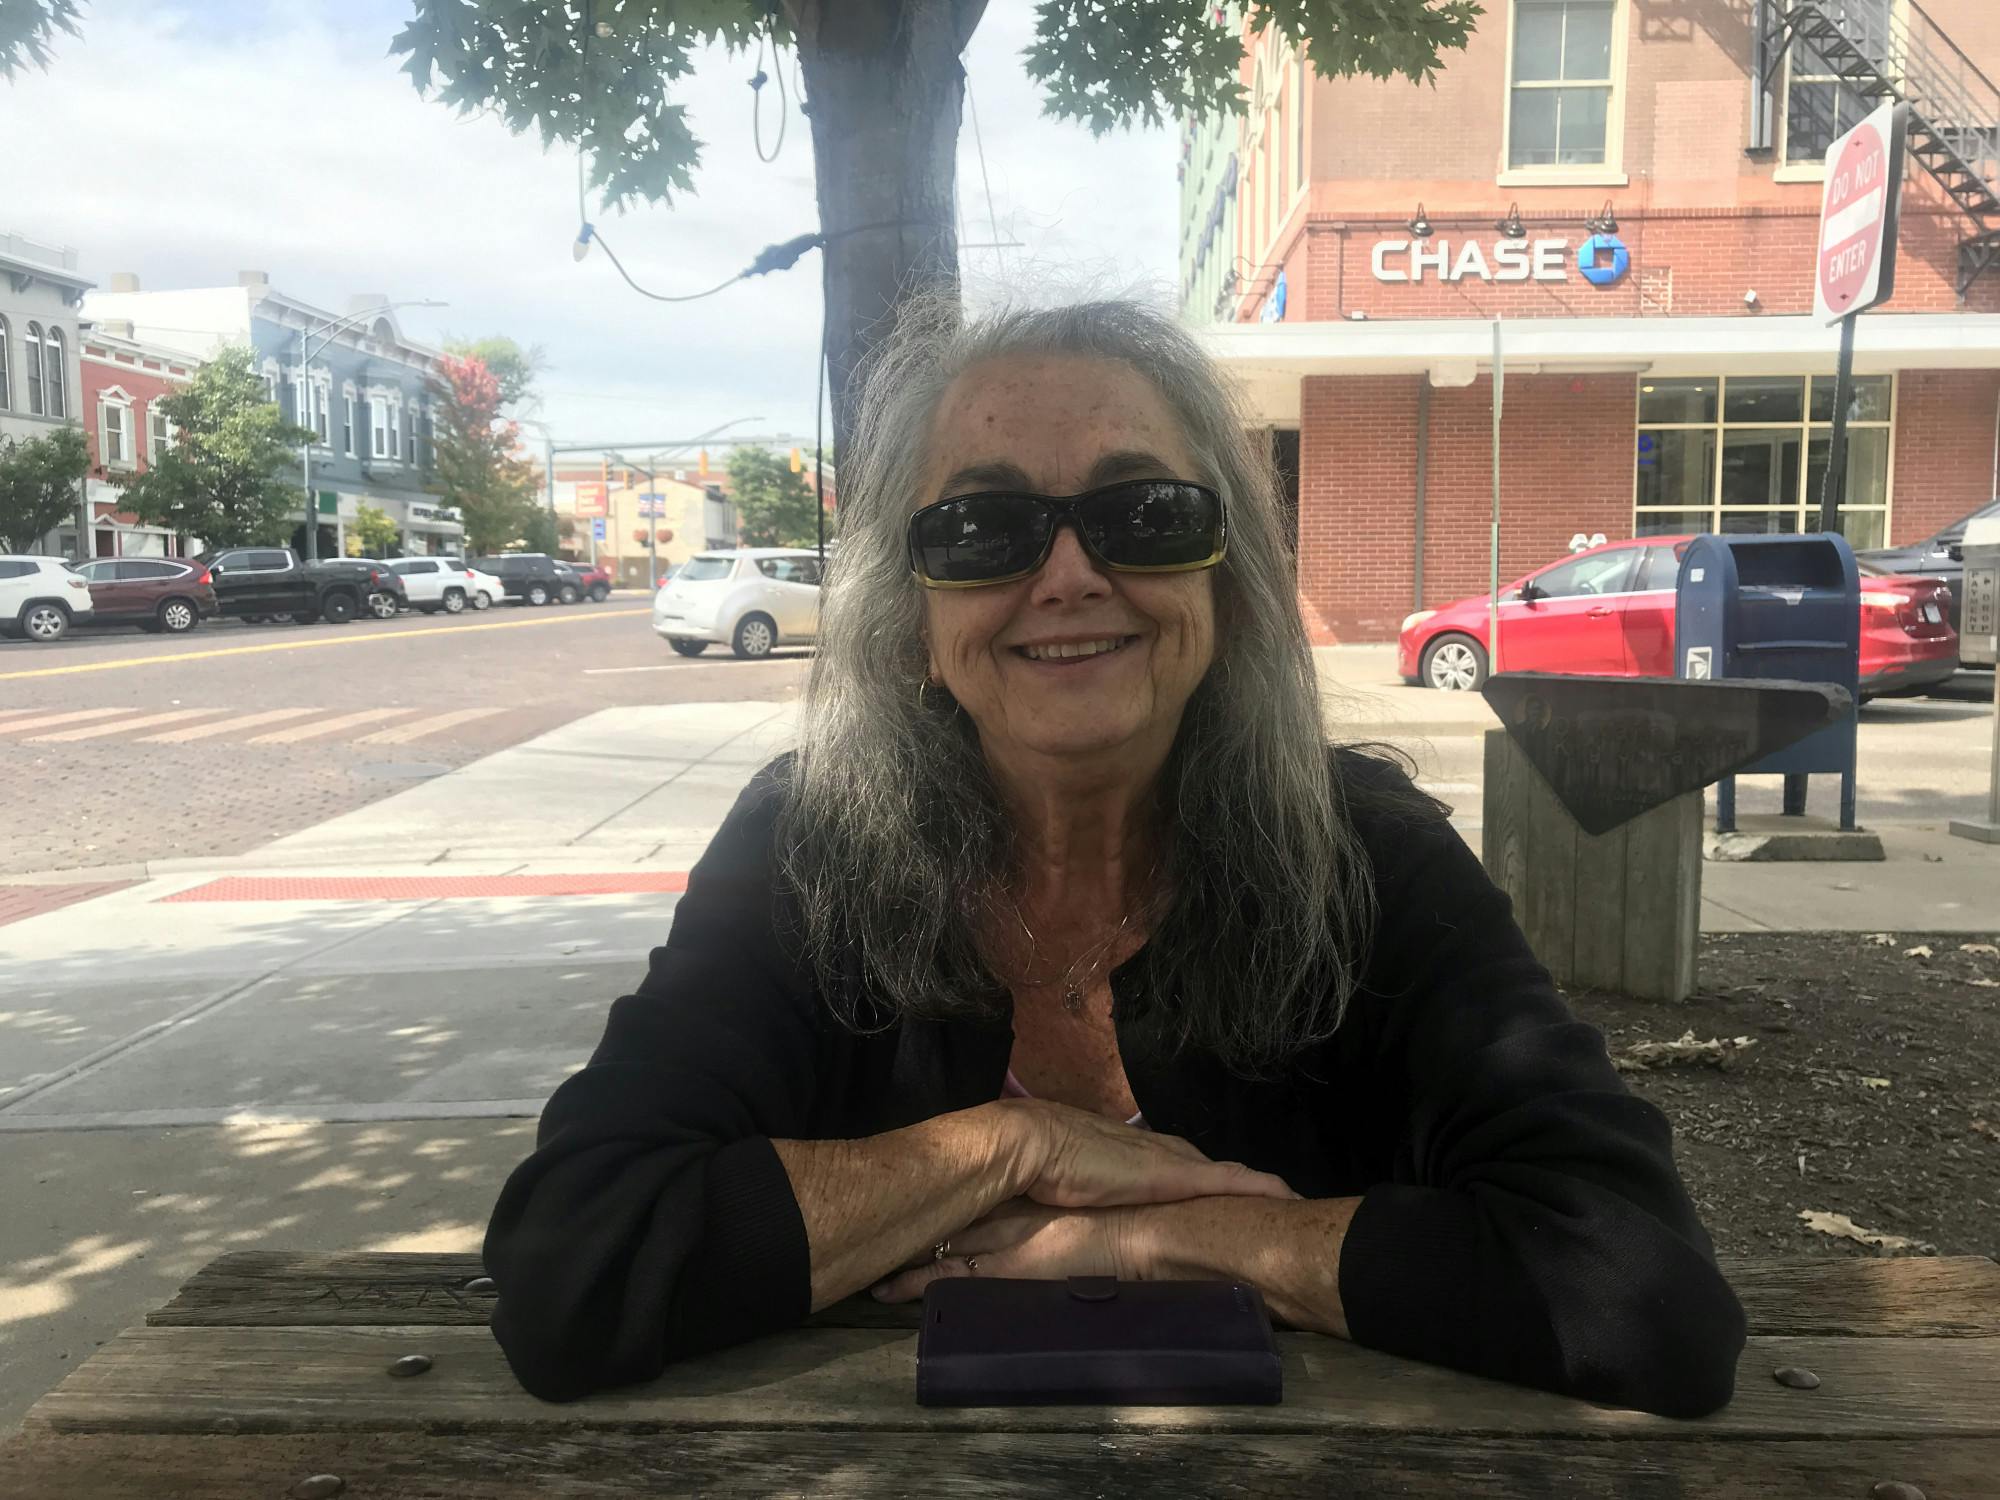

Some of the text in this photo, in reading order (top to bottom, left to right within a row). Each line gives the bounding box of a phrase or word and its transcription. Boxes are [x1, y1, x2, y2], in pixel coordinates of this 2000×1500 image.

[1832, 150, 1880, 206] DO NOT
[1371, 239, 1569, 281] CHASE
[1828, 239, 1867, 284] ENTER
[1969, 570, 1979, 632] PAYMENT
[1982, 593, 1990, 632] DROP
